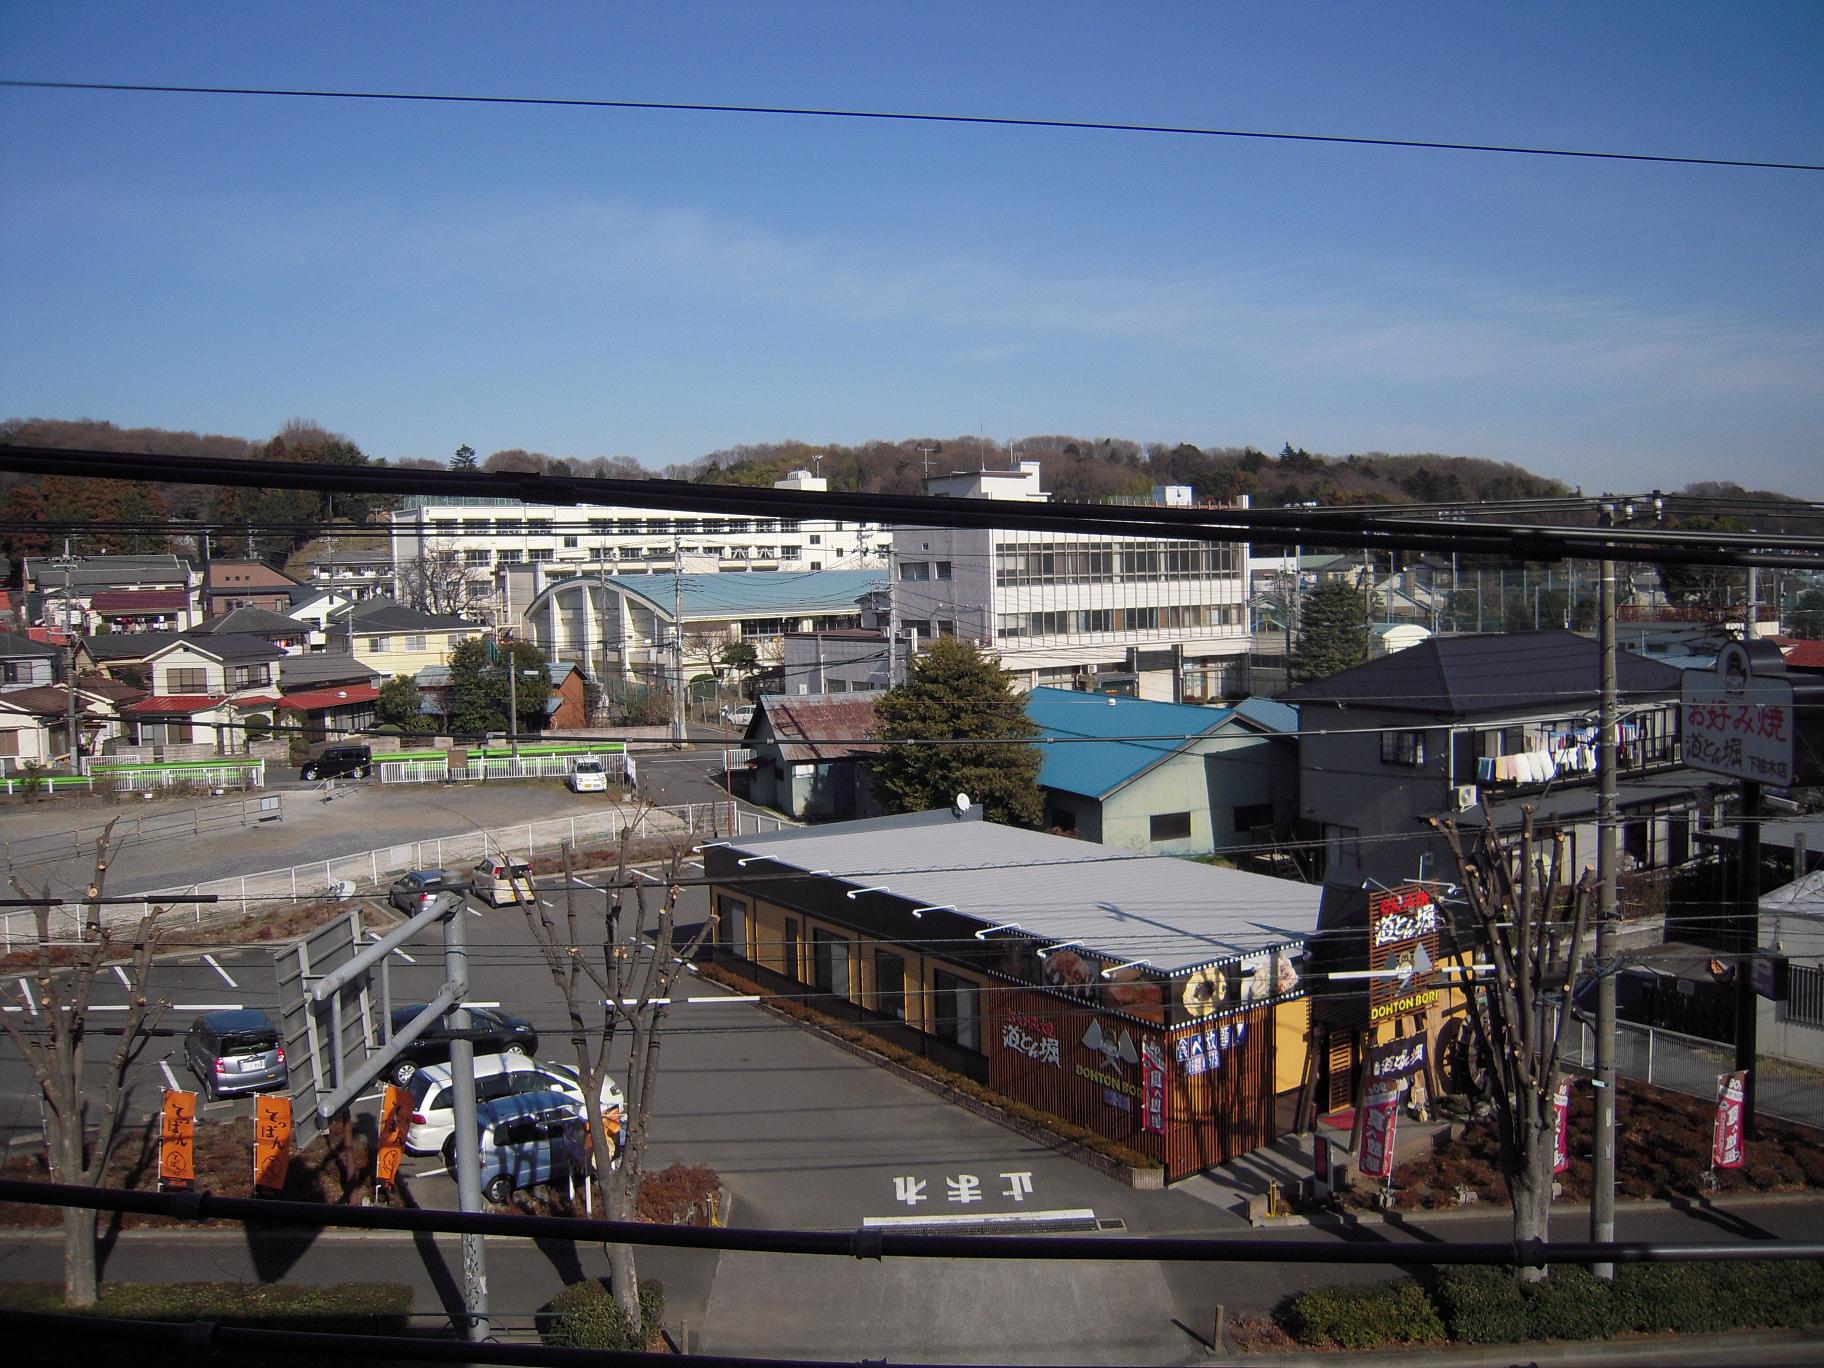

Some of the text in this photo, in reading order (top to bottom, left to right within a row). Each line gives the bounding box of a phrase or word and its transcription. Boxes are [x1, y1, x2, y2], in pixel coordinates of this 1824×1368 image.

[1689, 698, 1787, 742] お好み焼
[1686, 733, 1743, 771] 道とん堀
[1375, 903, 1436, 948] 道とん堀
[1371, 990, 1439, 1020] DOHTON BORI
[1002, 1024, 1061, 1069] 道とん堀
[1076, 1064, 1143, 1099] DOHTON BOR
[893, 1172, 1034, 1205] 止まれ
